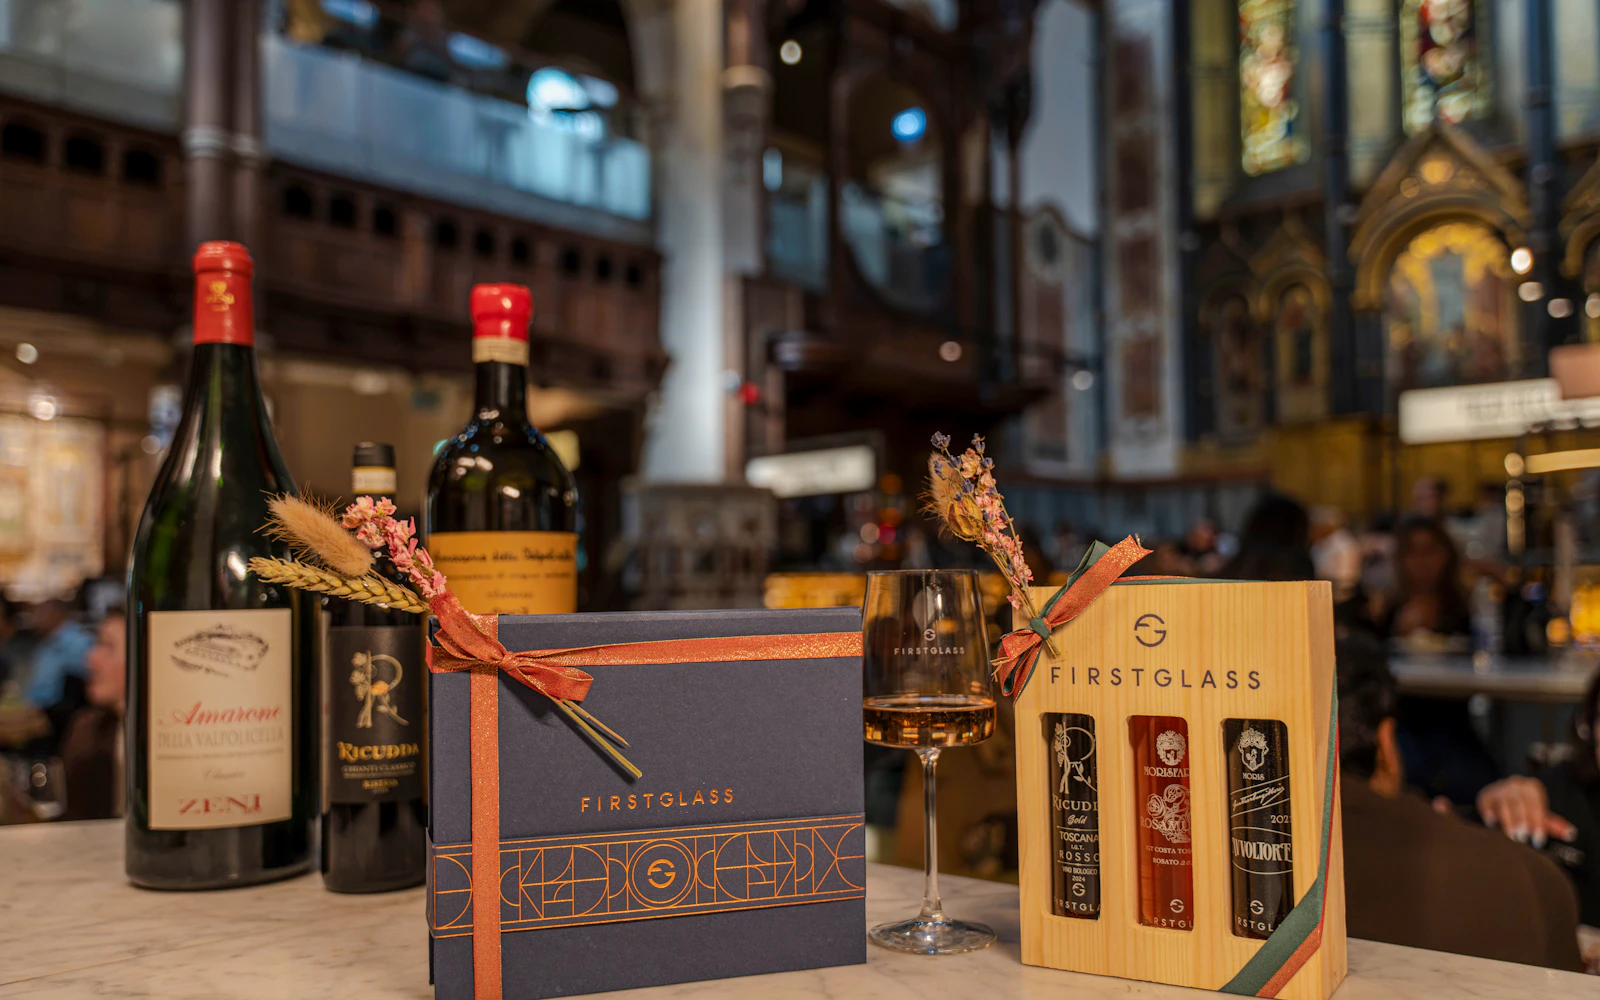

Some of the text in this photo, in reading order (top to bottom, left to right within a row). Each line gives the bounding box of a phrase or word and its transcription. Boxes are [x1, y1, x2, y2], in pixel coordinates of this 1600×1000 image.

[893, 646, 965, 655] FIRSTGLASS
[1051, 666, 1261, 690] FIRSTGLASS
[158, 700, 283, 727] Amarone
[1242, 772, 1265, 780] MORIS
[178, 793, 262, 815] ZENI
[581, 788, 734, 812] FIRSTGLASS
[1067, 814, 1088, 825] Gold
[1270, 814, 1291, 824] 202
[1059, 831, 1099, 843] TOSCANA
[1154, 846, 1176, 854] COSTA
[1059, 850, 1100, 862] ROSSO
[1152, 857, 1179, 865] ROSATO
